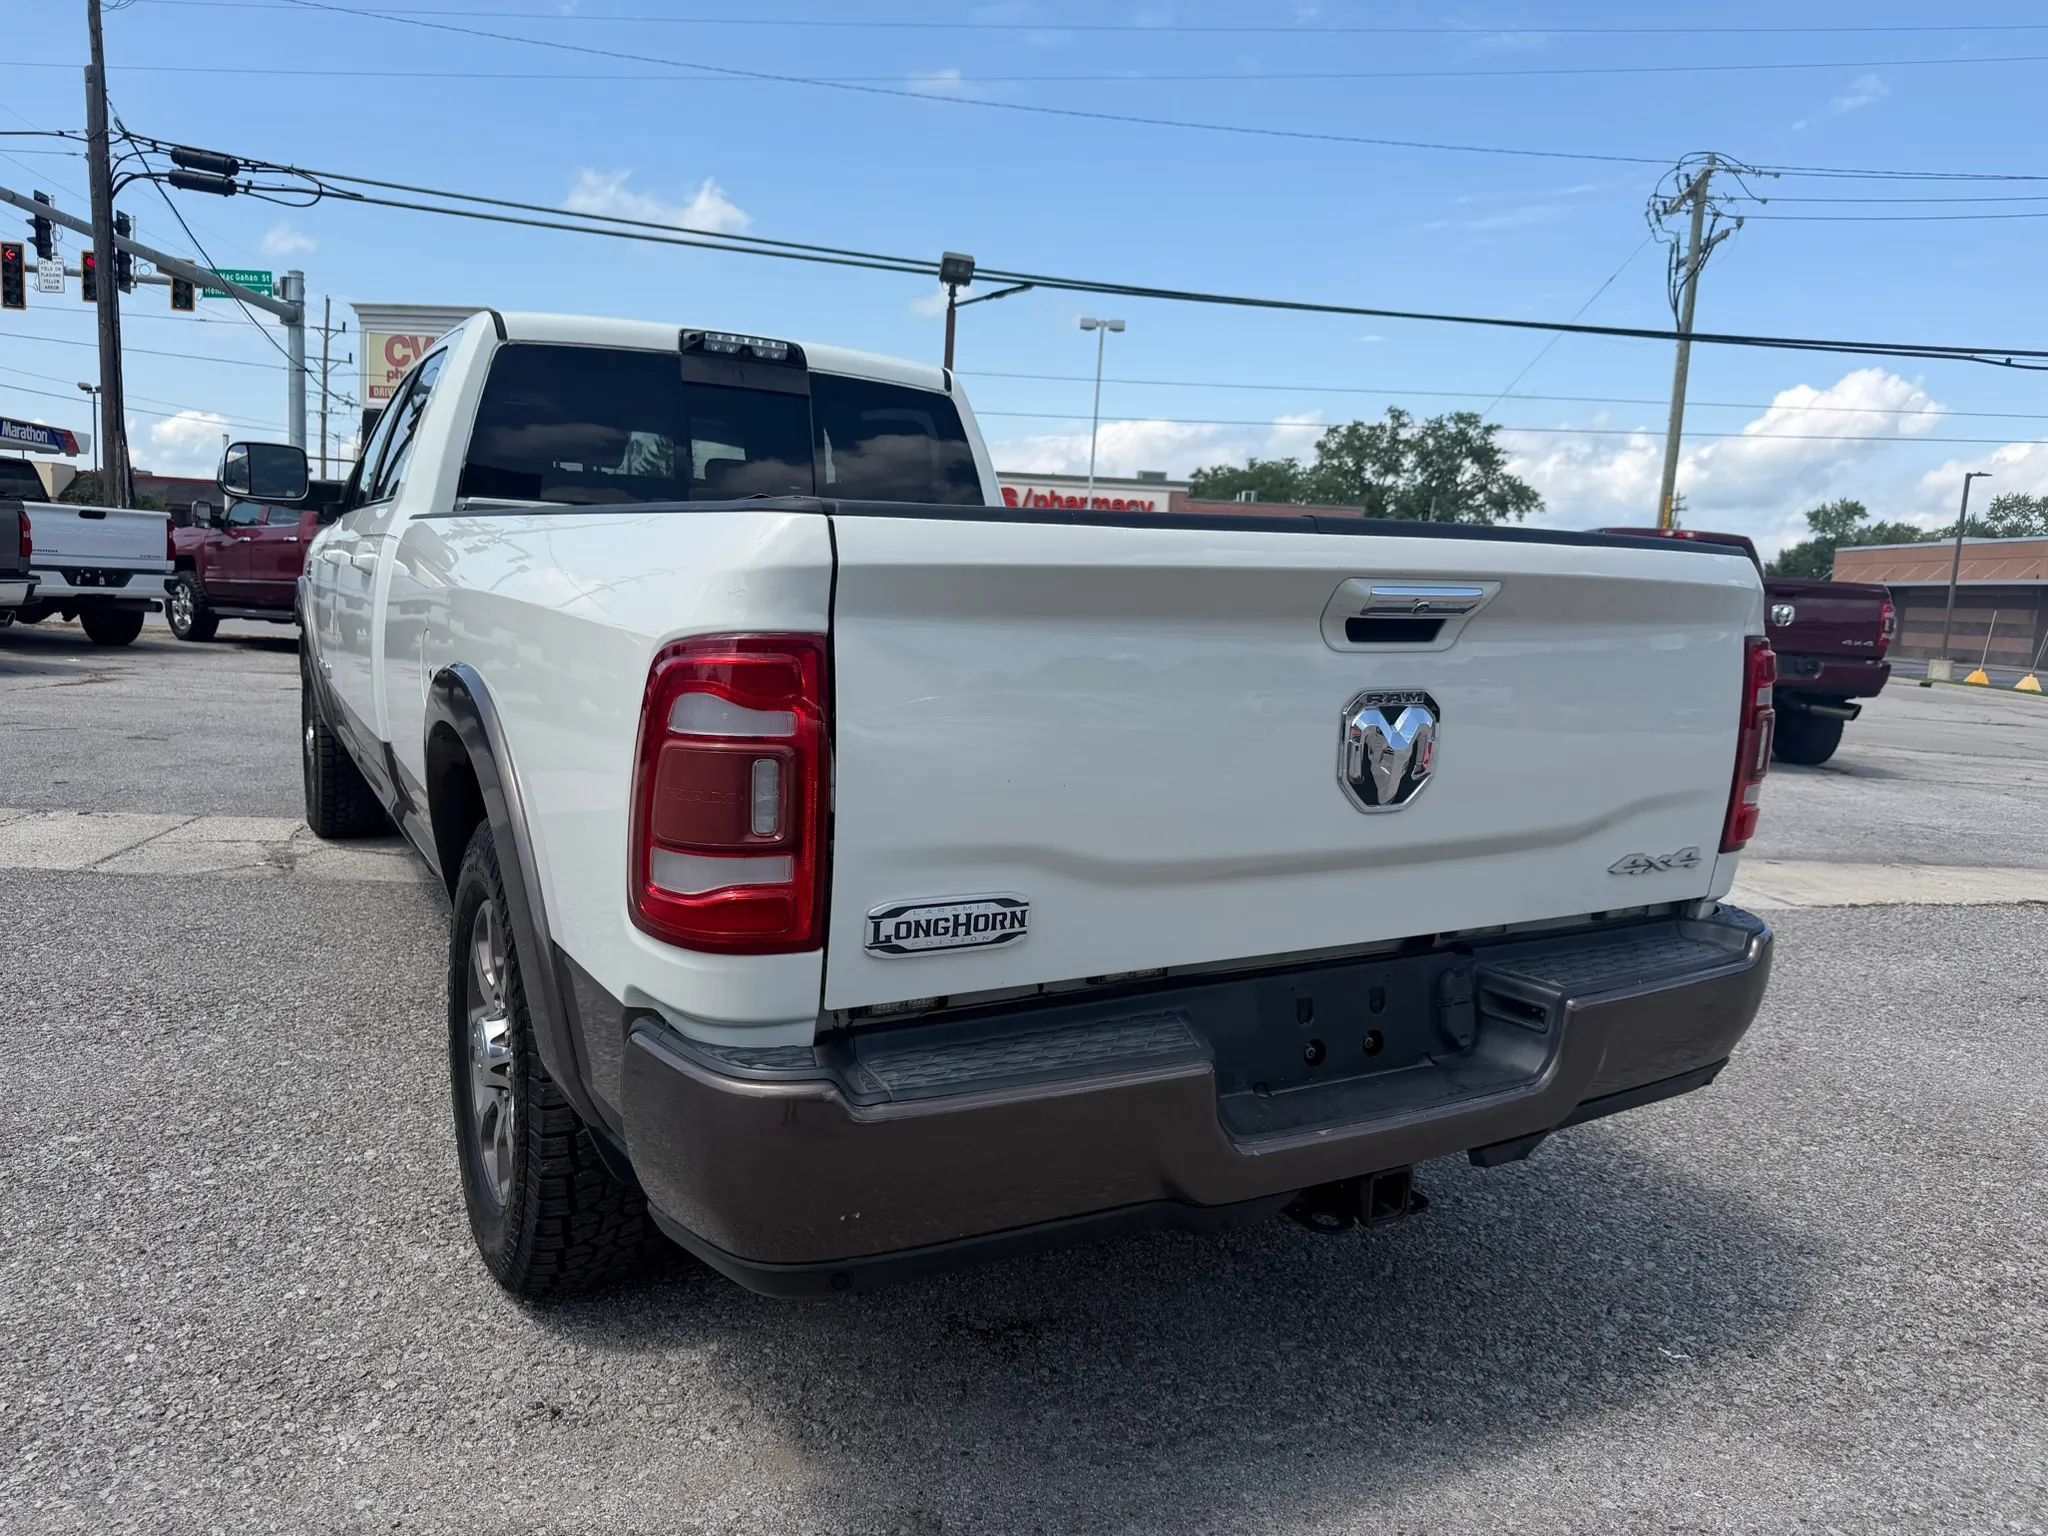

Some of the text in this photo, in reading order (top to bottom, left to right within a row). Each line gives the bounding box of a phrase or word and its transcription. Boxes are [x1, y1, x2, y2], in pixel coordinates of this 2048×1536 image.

[385, 335, 438, 367] CV
[2, 420, 48, 443] Marathon
[1366, 691, 1425, 705] RAM
[912, 903, 992, 916] LARAMIE
[868, 909, 1029, 946] LONGHORN
[911, 935, 990, 948] EDITION
